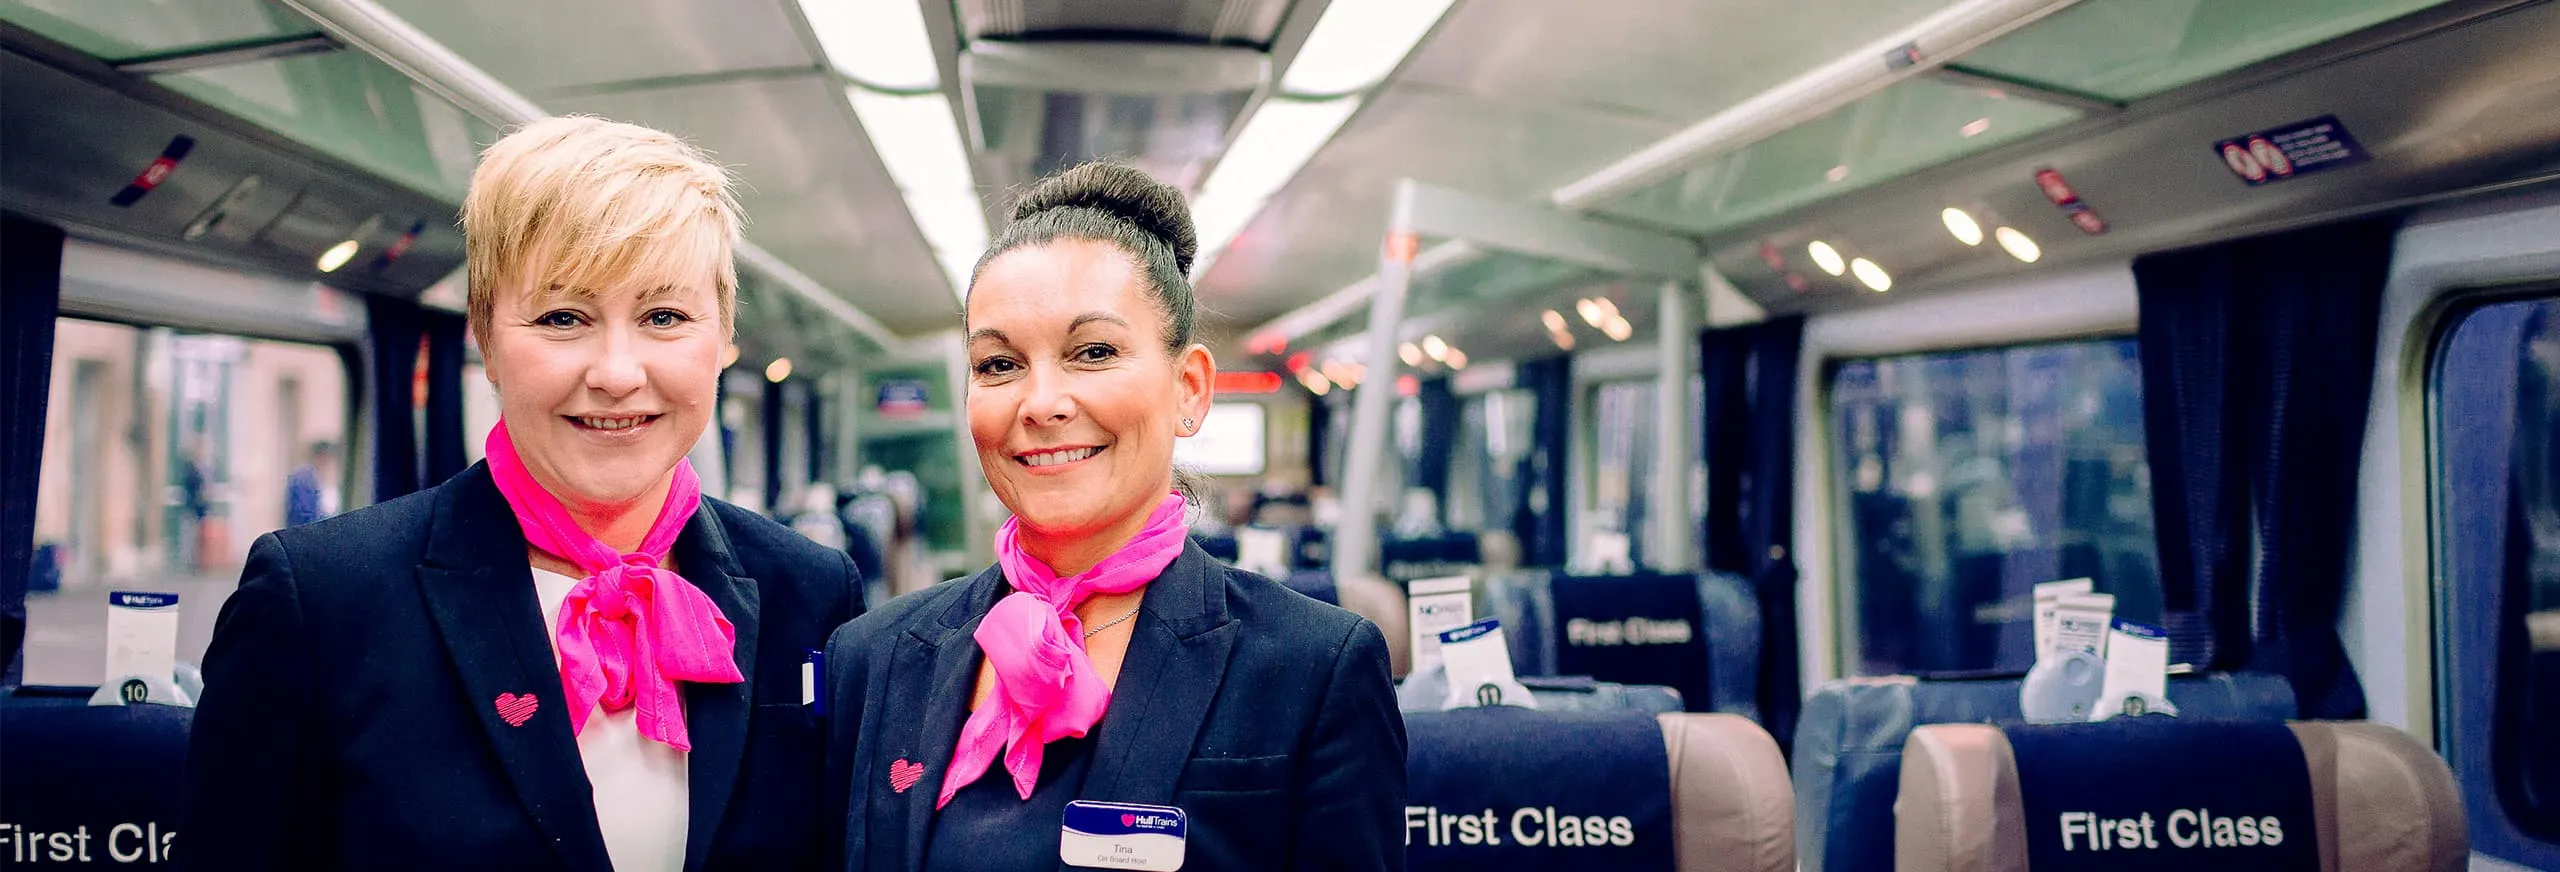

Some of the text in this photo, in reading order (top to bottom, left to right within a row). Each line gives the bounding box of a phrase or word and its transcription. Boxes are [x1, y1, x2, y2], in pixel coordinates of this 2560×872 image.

[125, 684, 146, 702] 10
[1405, 805, 1635, 848] First Class
[2059, 807, 2284, 851] First Class
[1112, 843, 1134, 855] Tina
[1097, 854, 1147, 866] On Board Host
